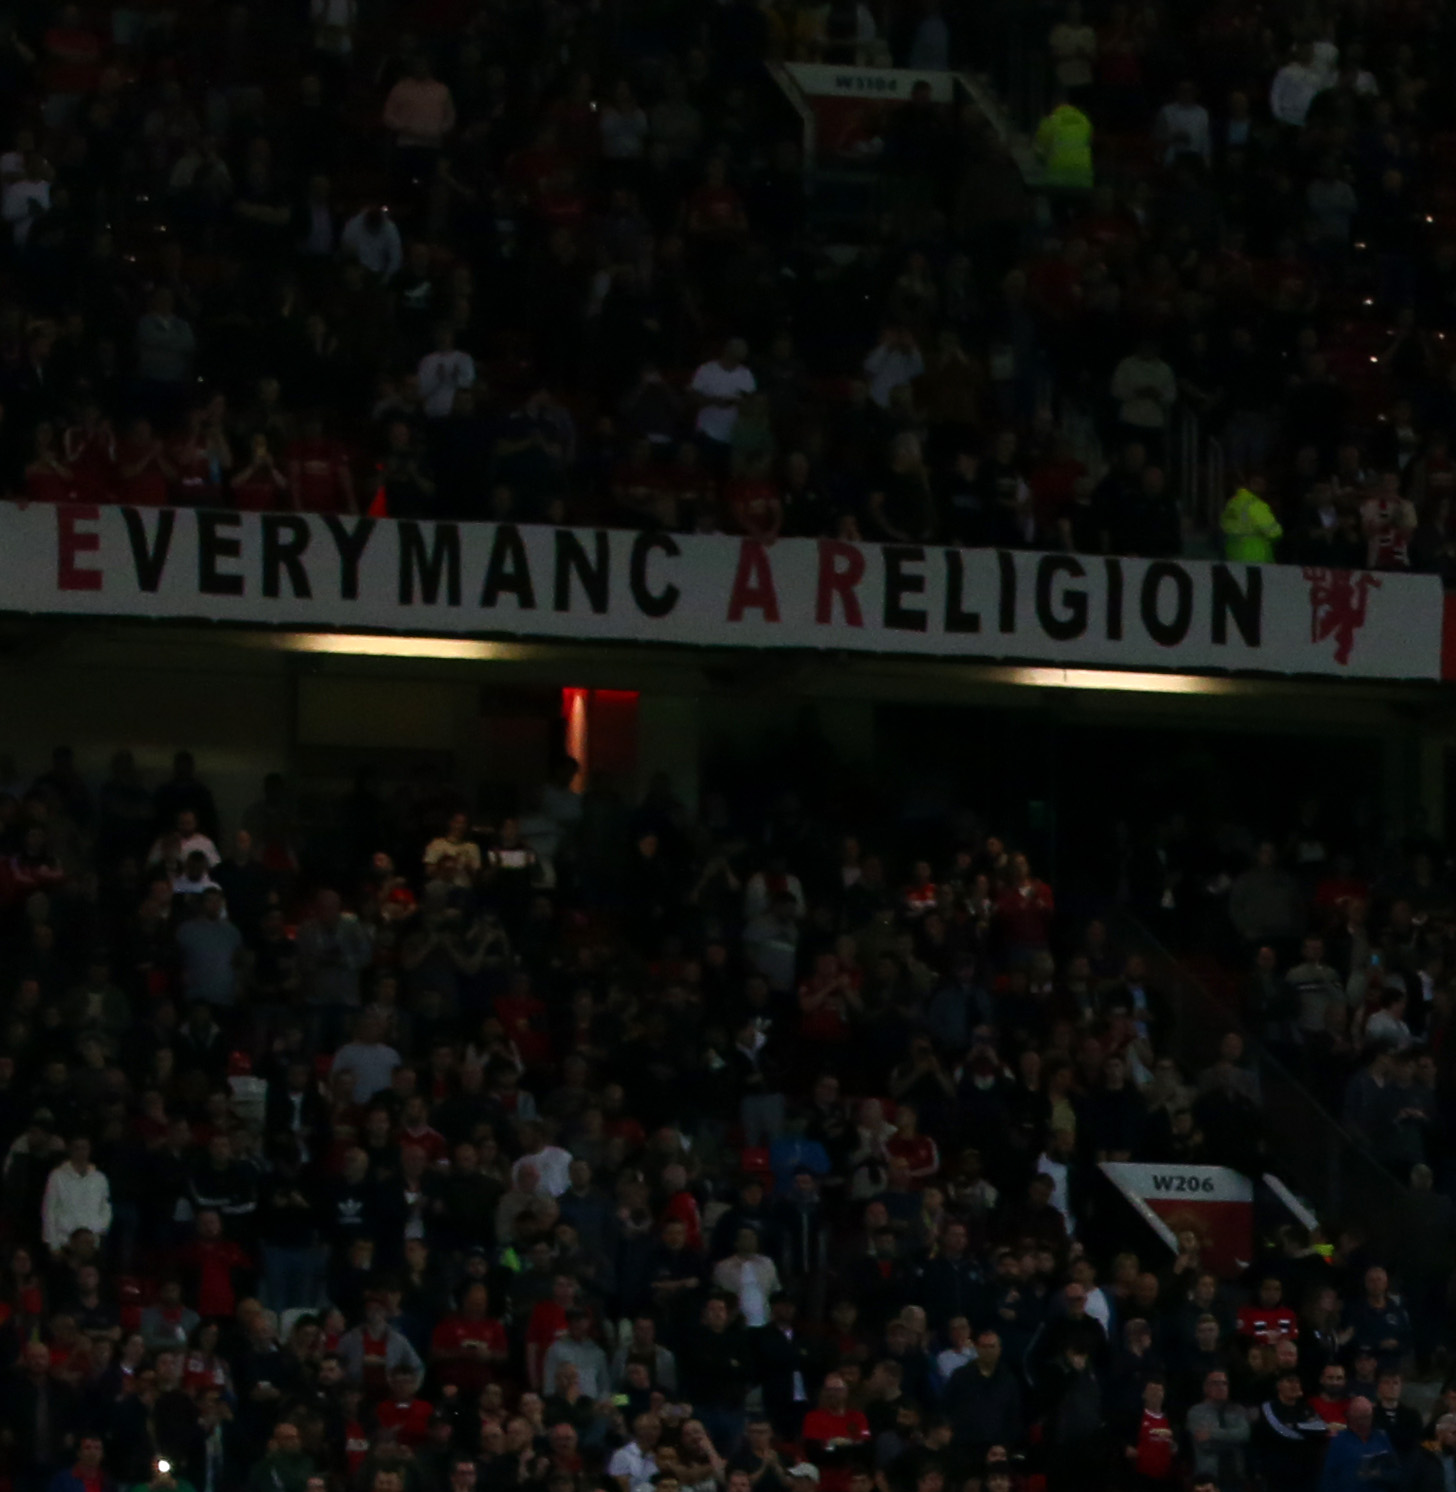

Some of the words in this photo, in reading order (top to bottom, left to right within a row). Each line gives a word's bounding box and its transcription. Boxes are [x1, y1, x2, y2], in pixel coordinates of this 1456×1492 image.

[725, 538, 782, 624] A
[814, 539, 1263, 649] RELIGION
[1152, 1174, 1215, 1193] W206
